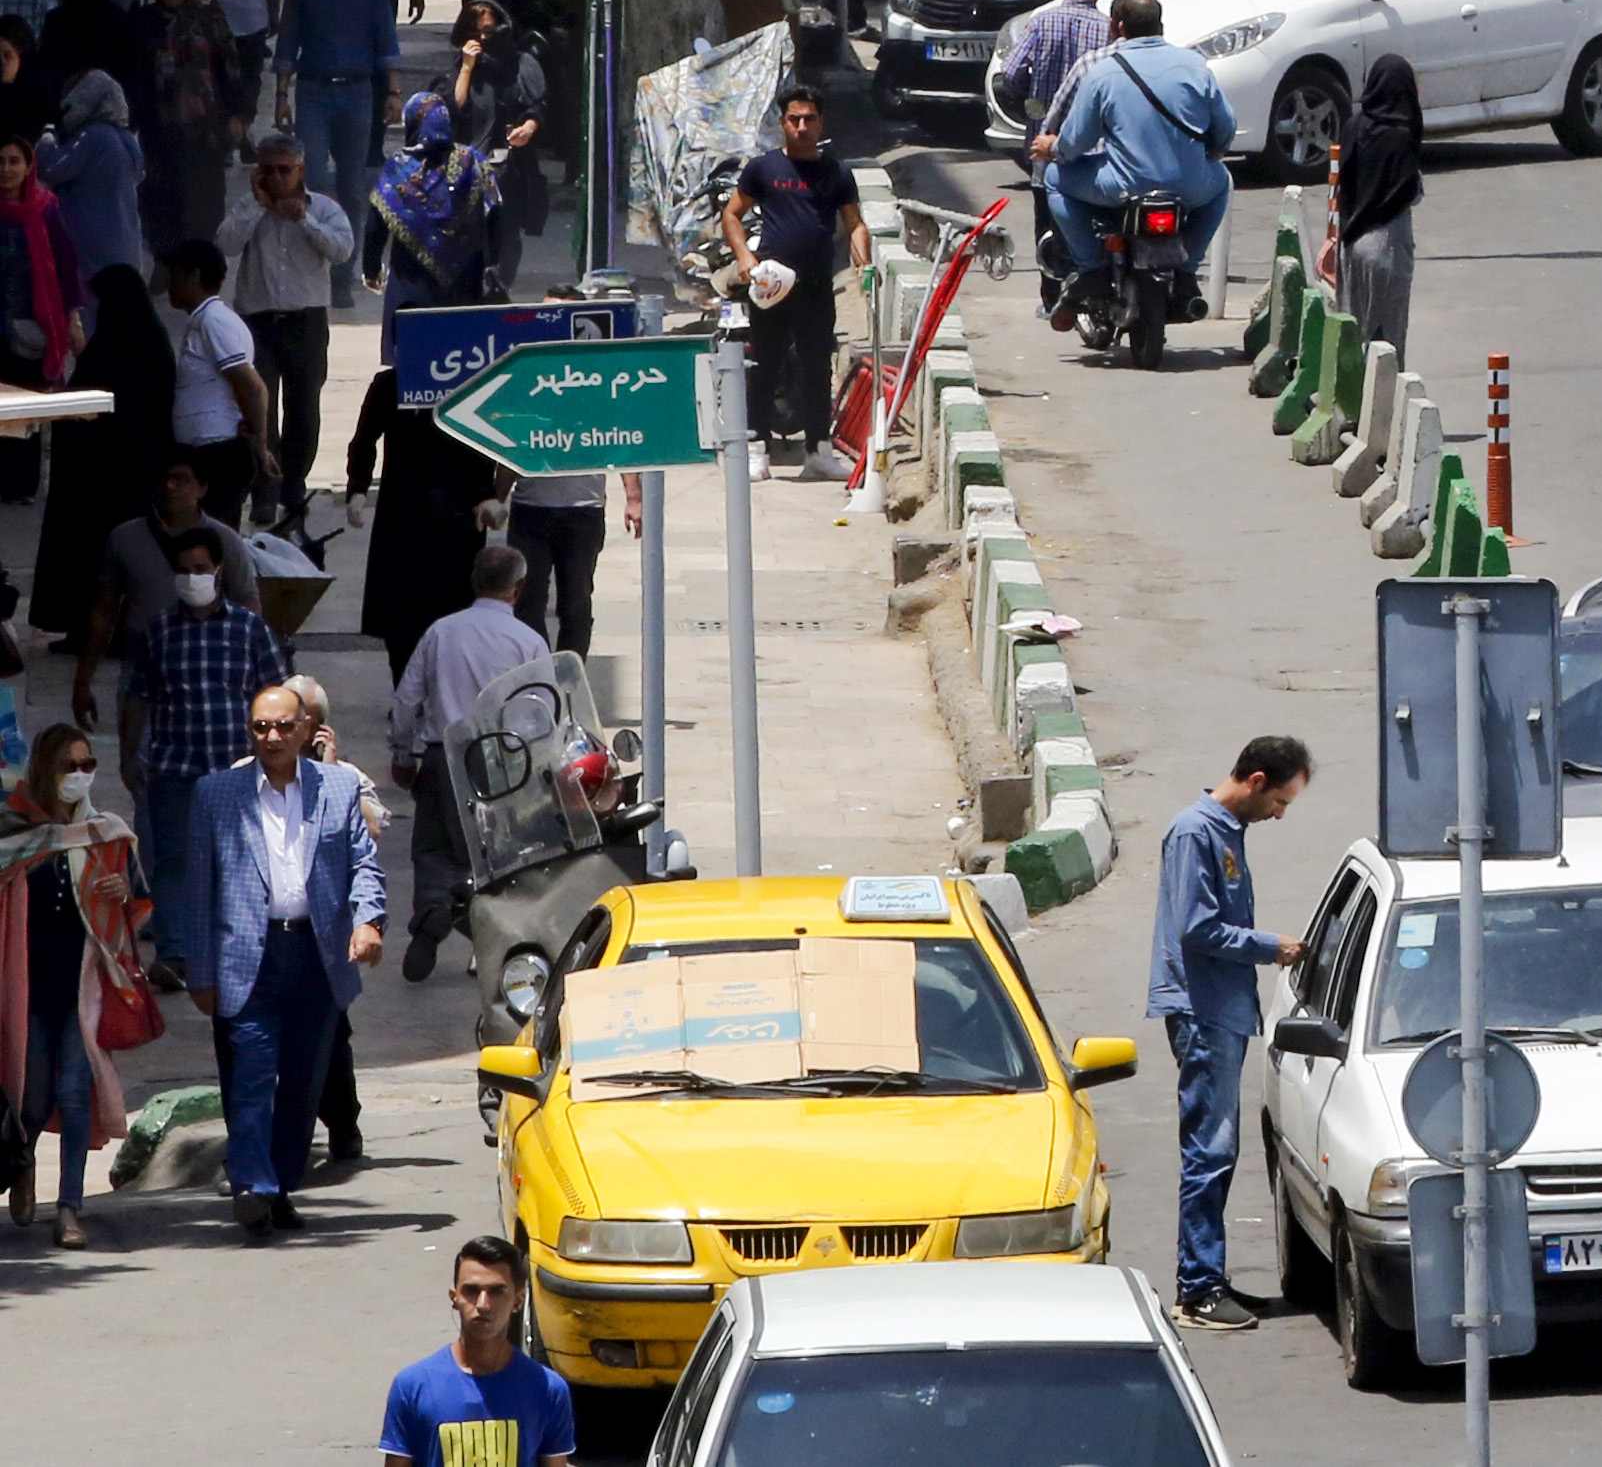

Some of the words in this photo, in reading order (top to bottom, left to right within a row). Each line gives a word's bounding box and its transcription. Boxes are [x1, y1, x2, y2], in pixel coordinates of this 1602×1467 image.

[535, 308, 564, 322] کوچه
[529, 364, 602, 397] مطهر
[610, 366, 668, 399] حرم
[530, 429, 575, 452] Holy
[580, 427, 644, 447] shrine
